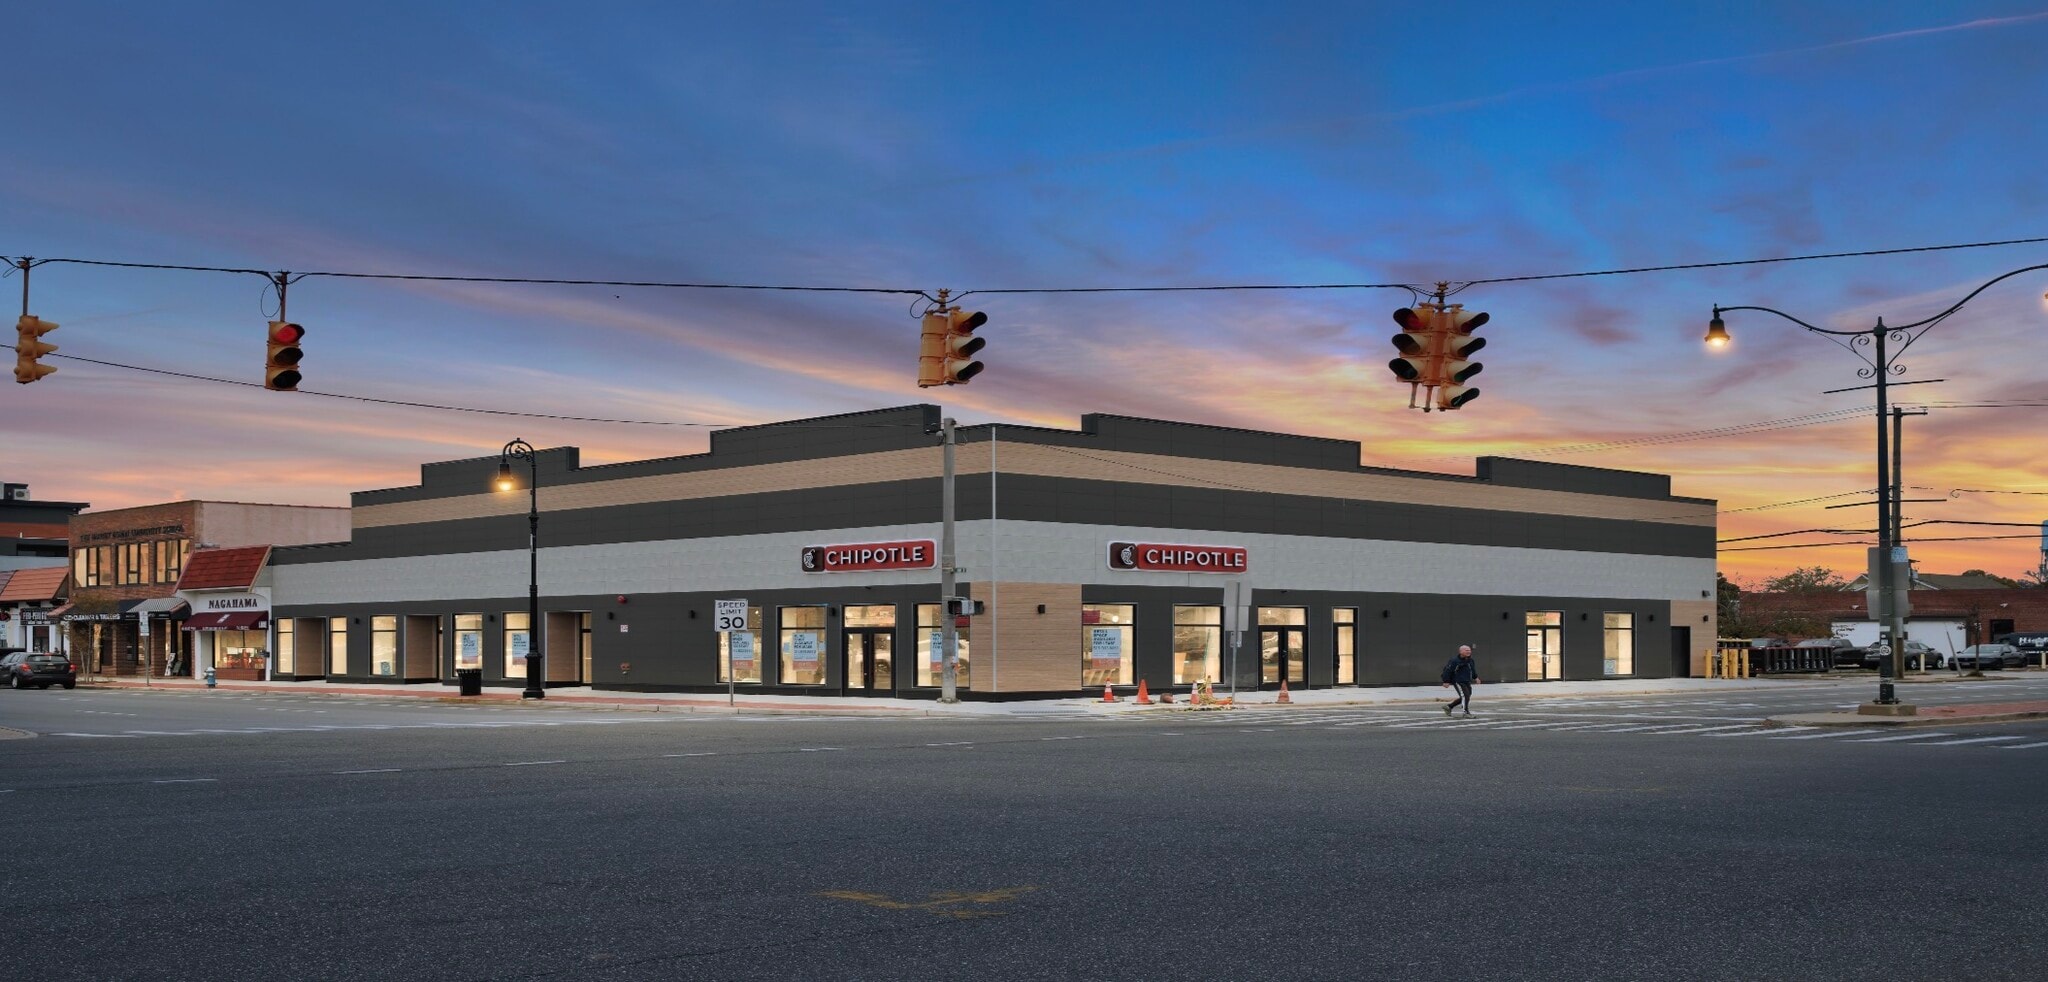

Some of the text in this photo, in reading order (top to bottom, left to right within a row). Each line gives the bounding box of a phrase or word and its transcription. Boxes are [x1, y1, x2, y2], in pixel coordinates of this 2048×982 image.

[826, 546, 924, 566] CHIPOTLE
[1146, 549, 1244, 567] CHIPOTLE
[208, 598, 258, 609] NAGAHAMA
[719, 616, 745, 629] 30
